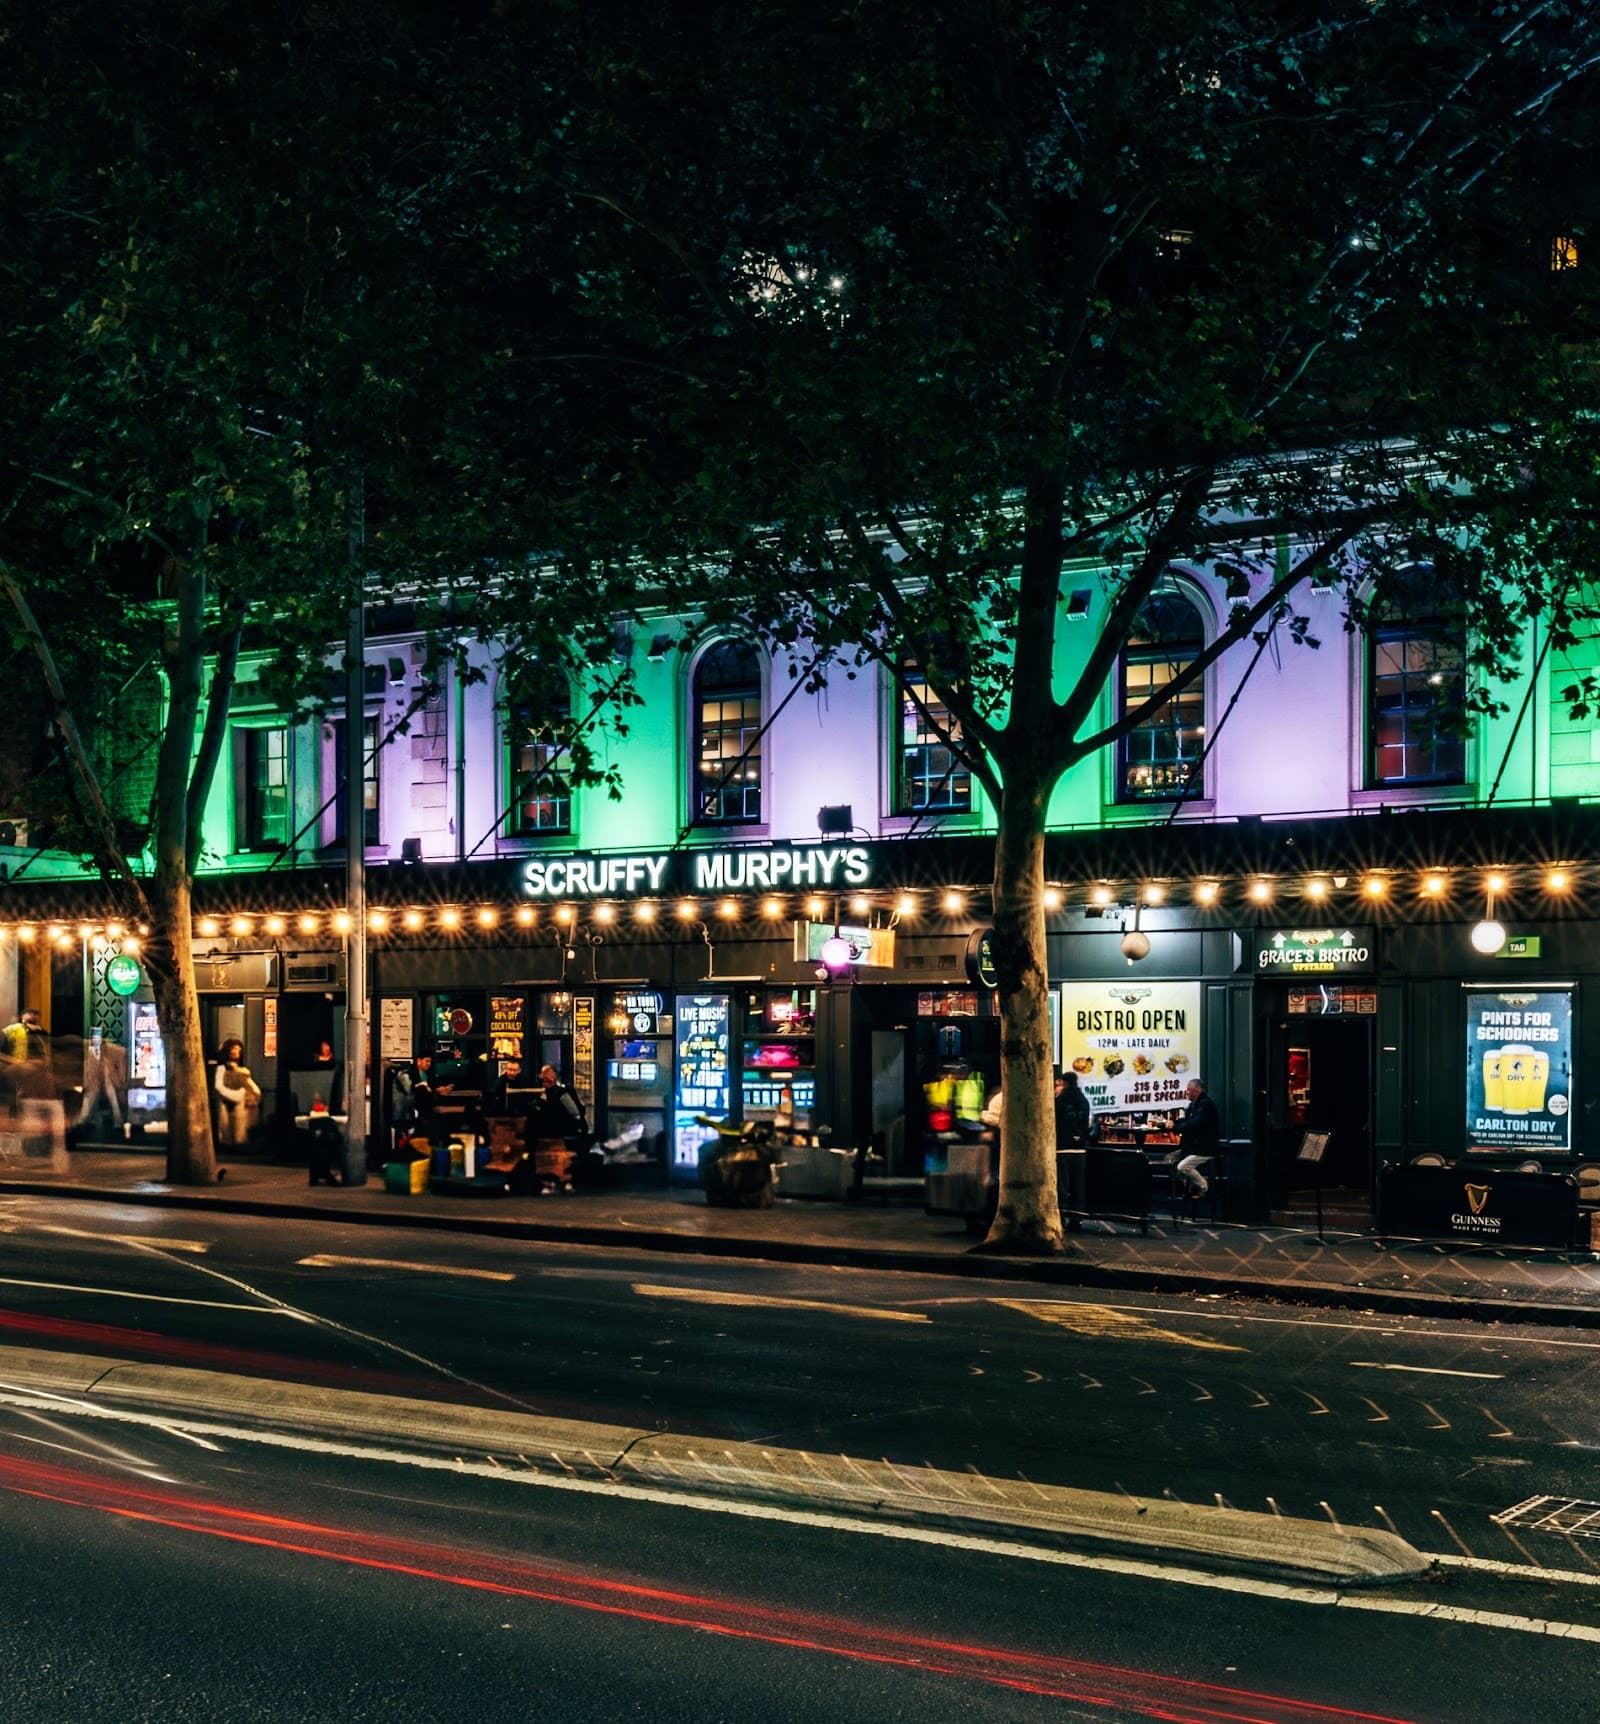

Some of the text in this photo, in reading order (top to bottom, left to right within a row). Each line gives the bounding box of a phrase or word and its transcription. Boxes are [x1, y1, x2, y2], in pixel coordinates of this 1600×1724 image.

[524, 848, 869, 894] SCRUFFY MURPHY'S
[1509, 943, 1526, 952] TAB
[1259, 947, 1368, 967] GRACE'S BISTRO
[1292, 963, 1335, 971] UPSTAIRS
[680, 1006, 726, 1021] LIVE MUSIC
[1077, 1009, 1186, 1031] BISTRO OPEN
[1481, 1011, 1552, 1026] PINTS FOR
[698, 1021, 717, 1034] DJ'S
[1476, 1026, 1560, 1042] SCHOONERS
[1097, 1038, 1118, 1048] 12PM
[1127, 1038, 1145, 1048] LATE
[1148, 1038, 1170, 1048] DAILY
[1134, 1082, 1150, 1092] $15
[1163, 1079, 1181, 1090] $18
[1124, 1094, 1151, 1104] LUNCH
[1476, 1118, 1556, 1132] CARLTON DRY
[1451, 1213, 1501, 1227] GUINNESS
